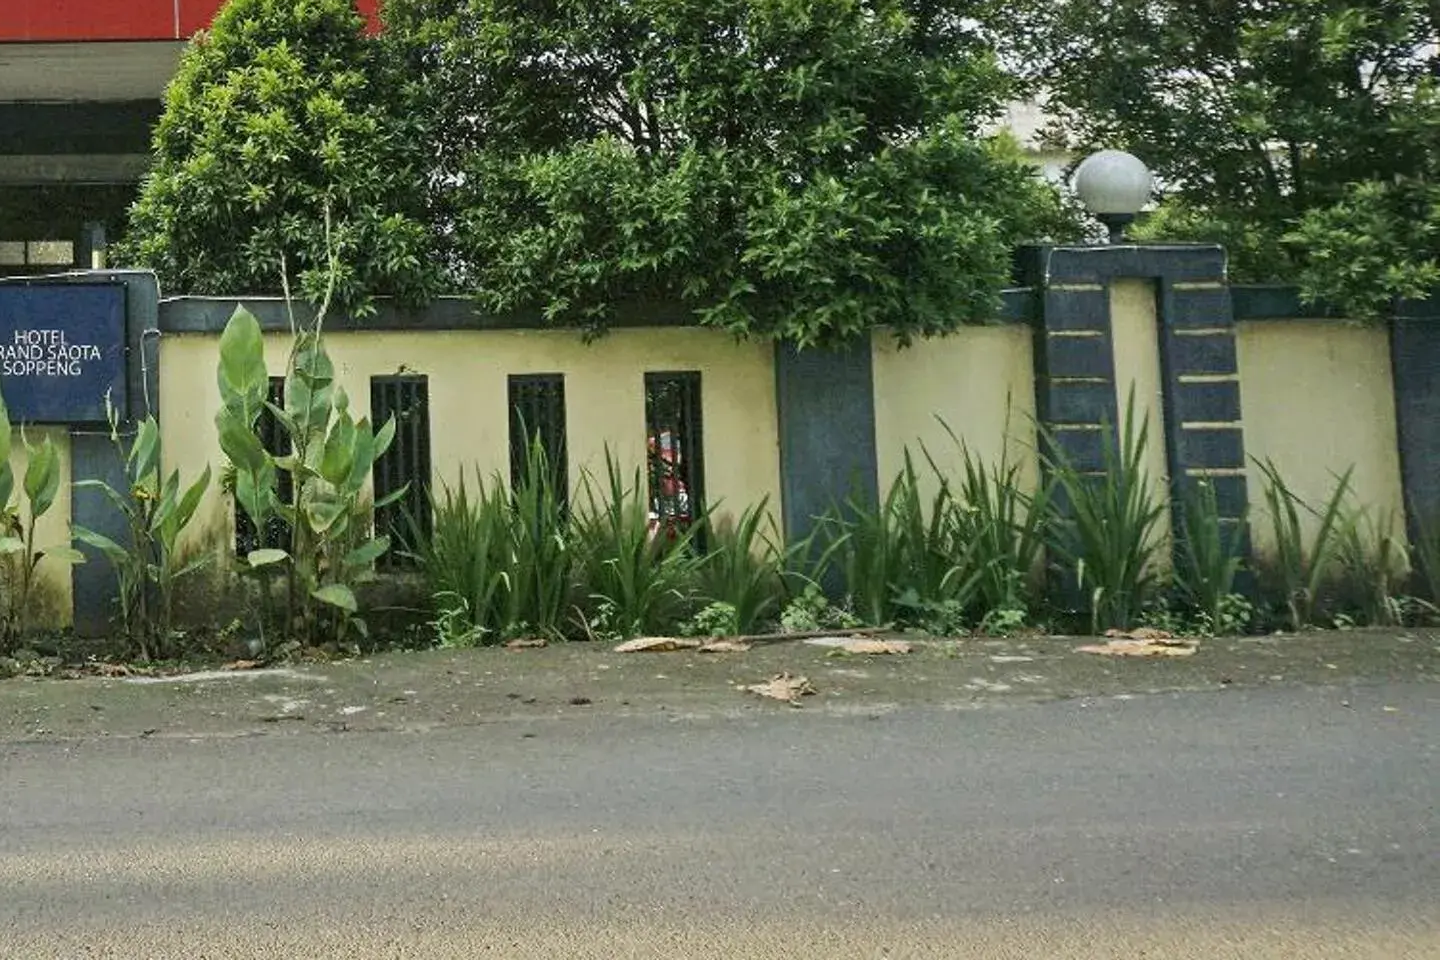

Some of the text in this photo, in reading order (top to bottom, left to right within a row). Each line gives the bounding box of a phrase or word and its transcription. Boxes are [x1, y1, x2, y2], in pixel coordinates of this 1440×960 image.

[14, 330, 67, 345] HOTEL
[47, 345, 101, 360] SAOTA
[3, 360, 81, 376] SOPPENG
